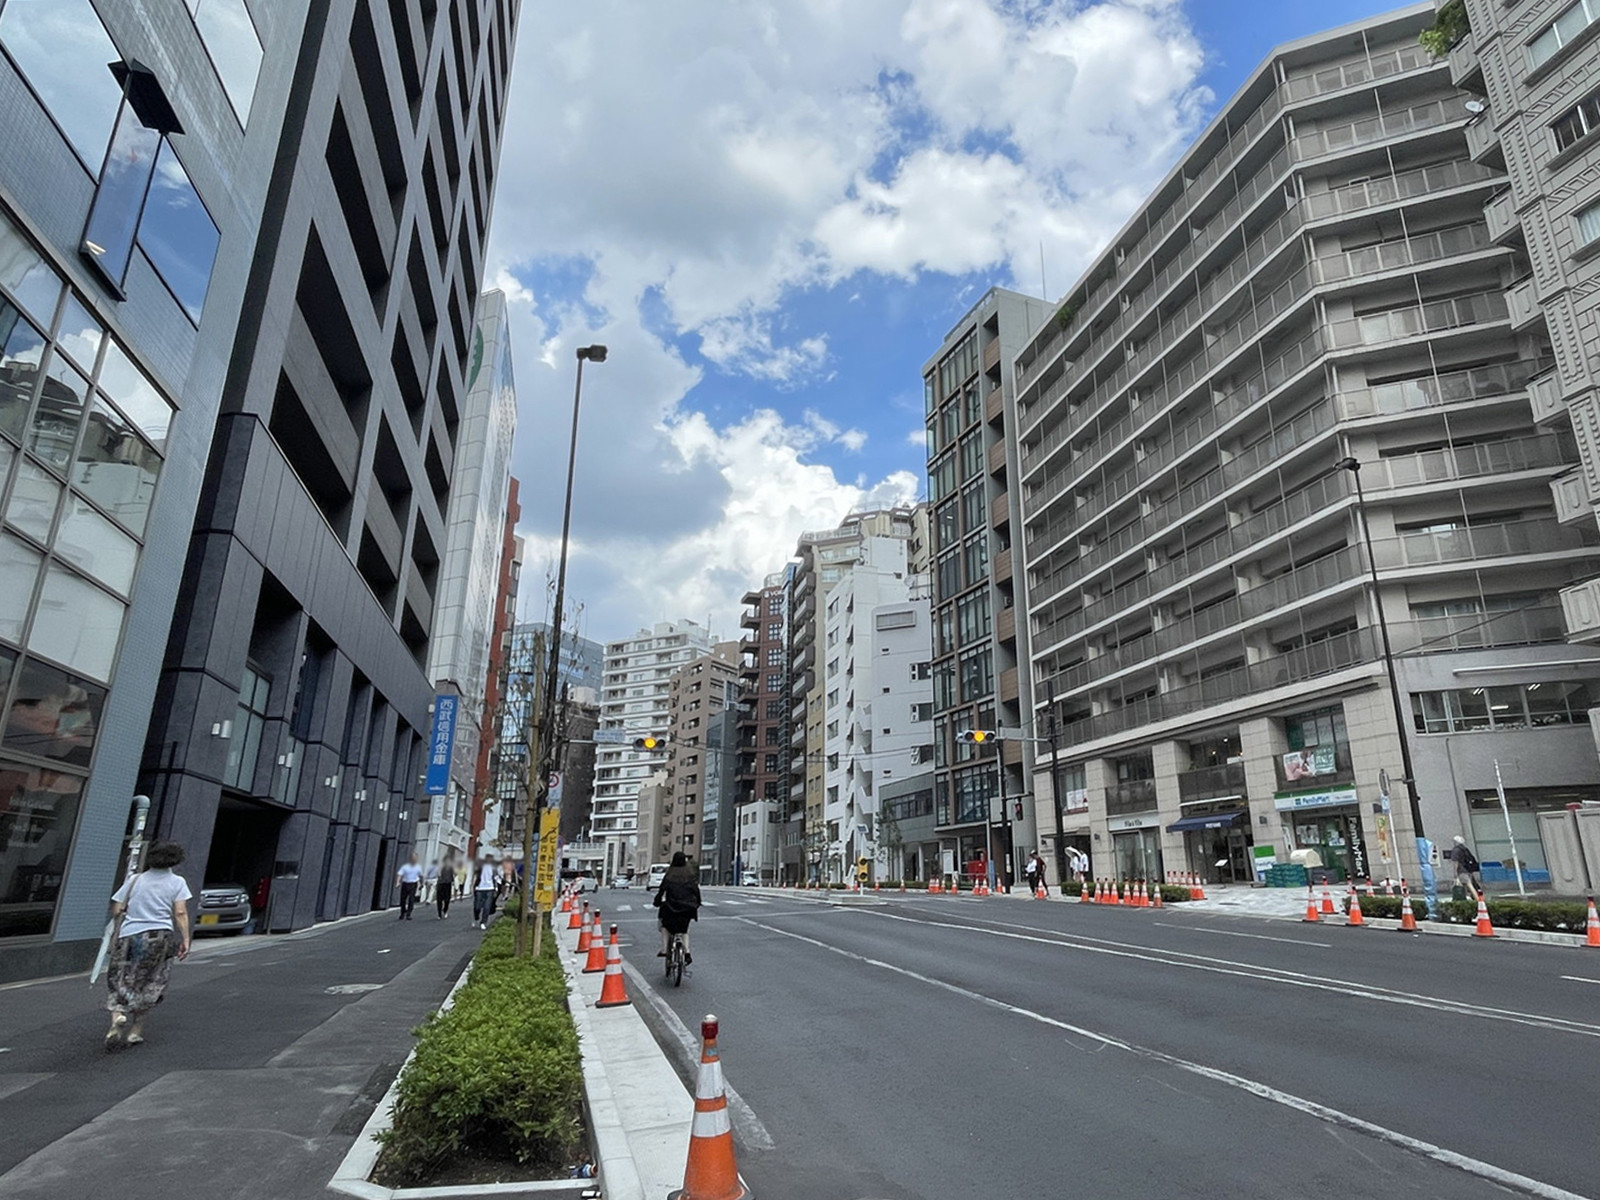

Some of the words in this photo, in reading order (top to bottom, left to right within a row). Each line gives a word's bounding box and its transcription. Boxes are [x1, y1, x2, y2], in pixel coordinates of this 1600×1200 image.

[433, 699, 453, 765] 西武信用金庫
[1348, 817, 1365, 877] FamilyMart
